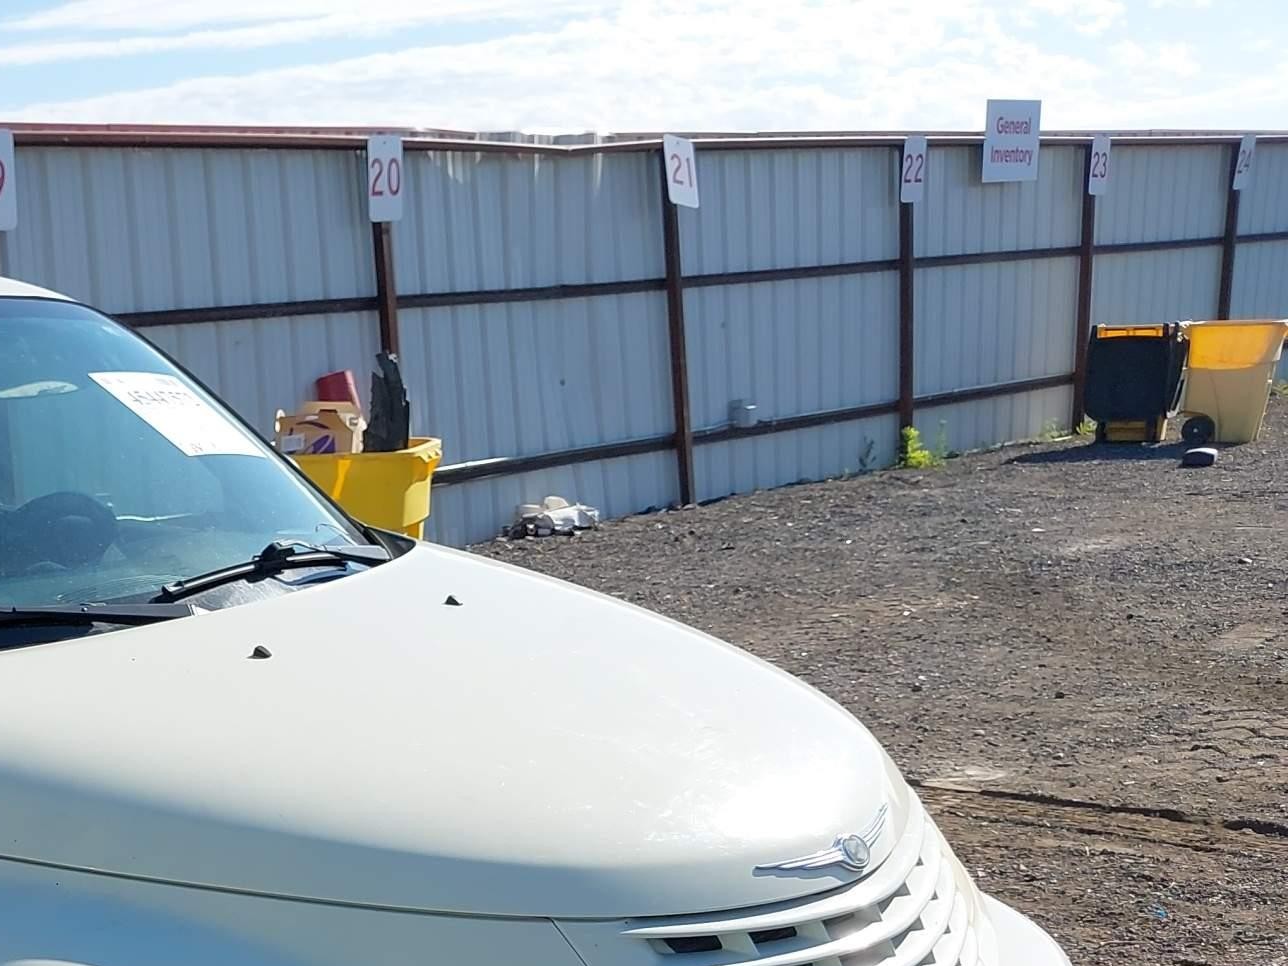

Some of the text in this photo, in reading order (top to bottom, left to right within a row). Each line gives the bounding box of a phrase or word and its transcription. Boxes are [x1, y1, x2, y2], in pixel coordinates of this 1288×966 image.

[996, 116, 1032, 135] General
[903, 153, 924, 183] 22
[990, 145, 1033, 166] Inventory
[1091, 151, 1108, 178] 23
[1237, 150, 1252, 174] 24
[370, 158, 401, 197] 20
[670, 153, 693, 188] 21
